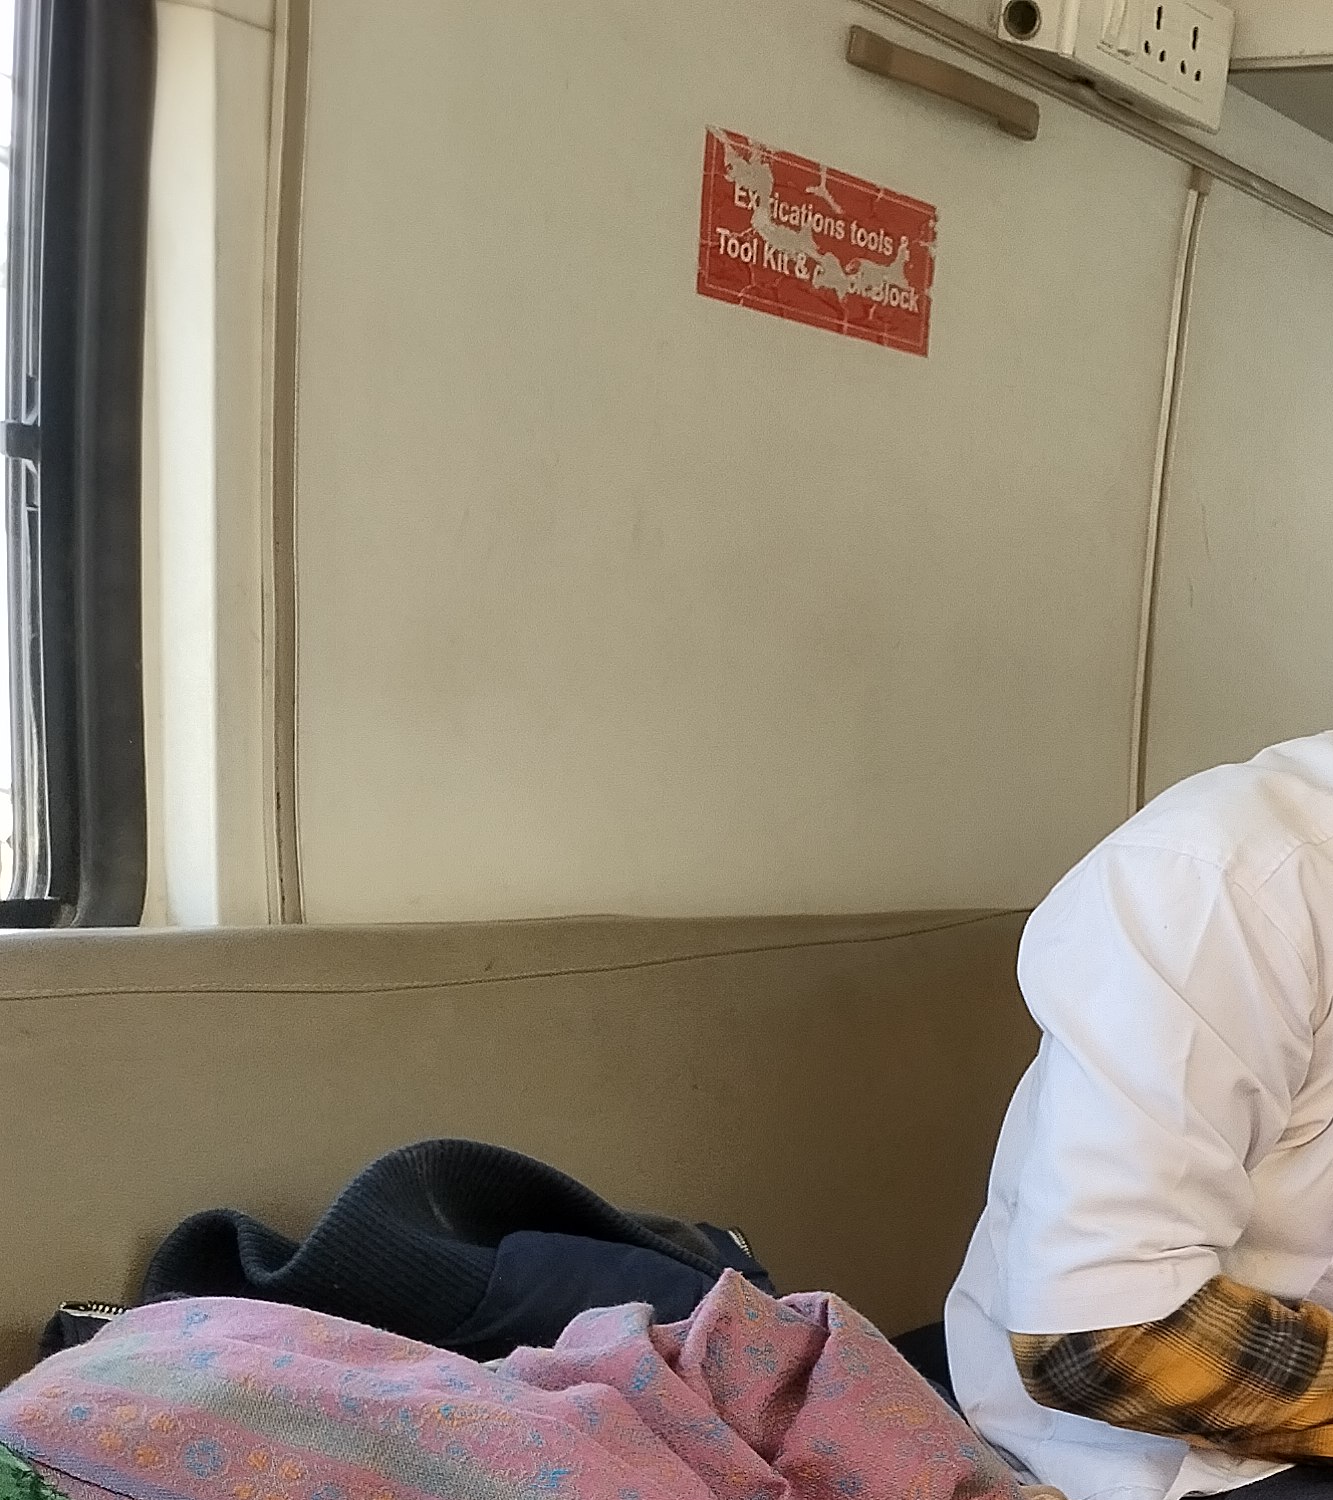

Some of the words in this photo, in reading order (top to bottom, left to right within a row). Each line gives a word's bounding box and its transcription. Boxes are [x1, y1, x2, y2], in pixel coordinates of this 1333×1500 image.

[734, 183, 845, 240] Exications
[850, 219, 893, 256] tools
[716, 227, 758, 265] Tool
[795, 251, 811, 280] &
